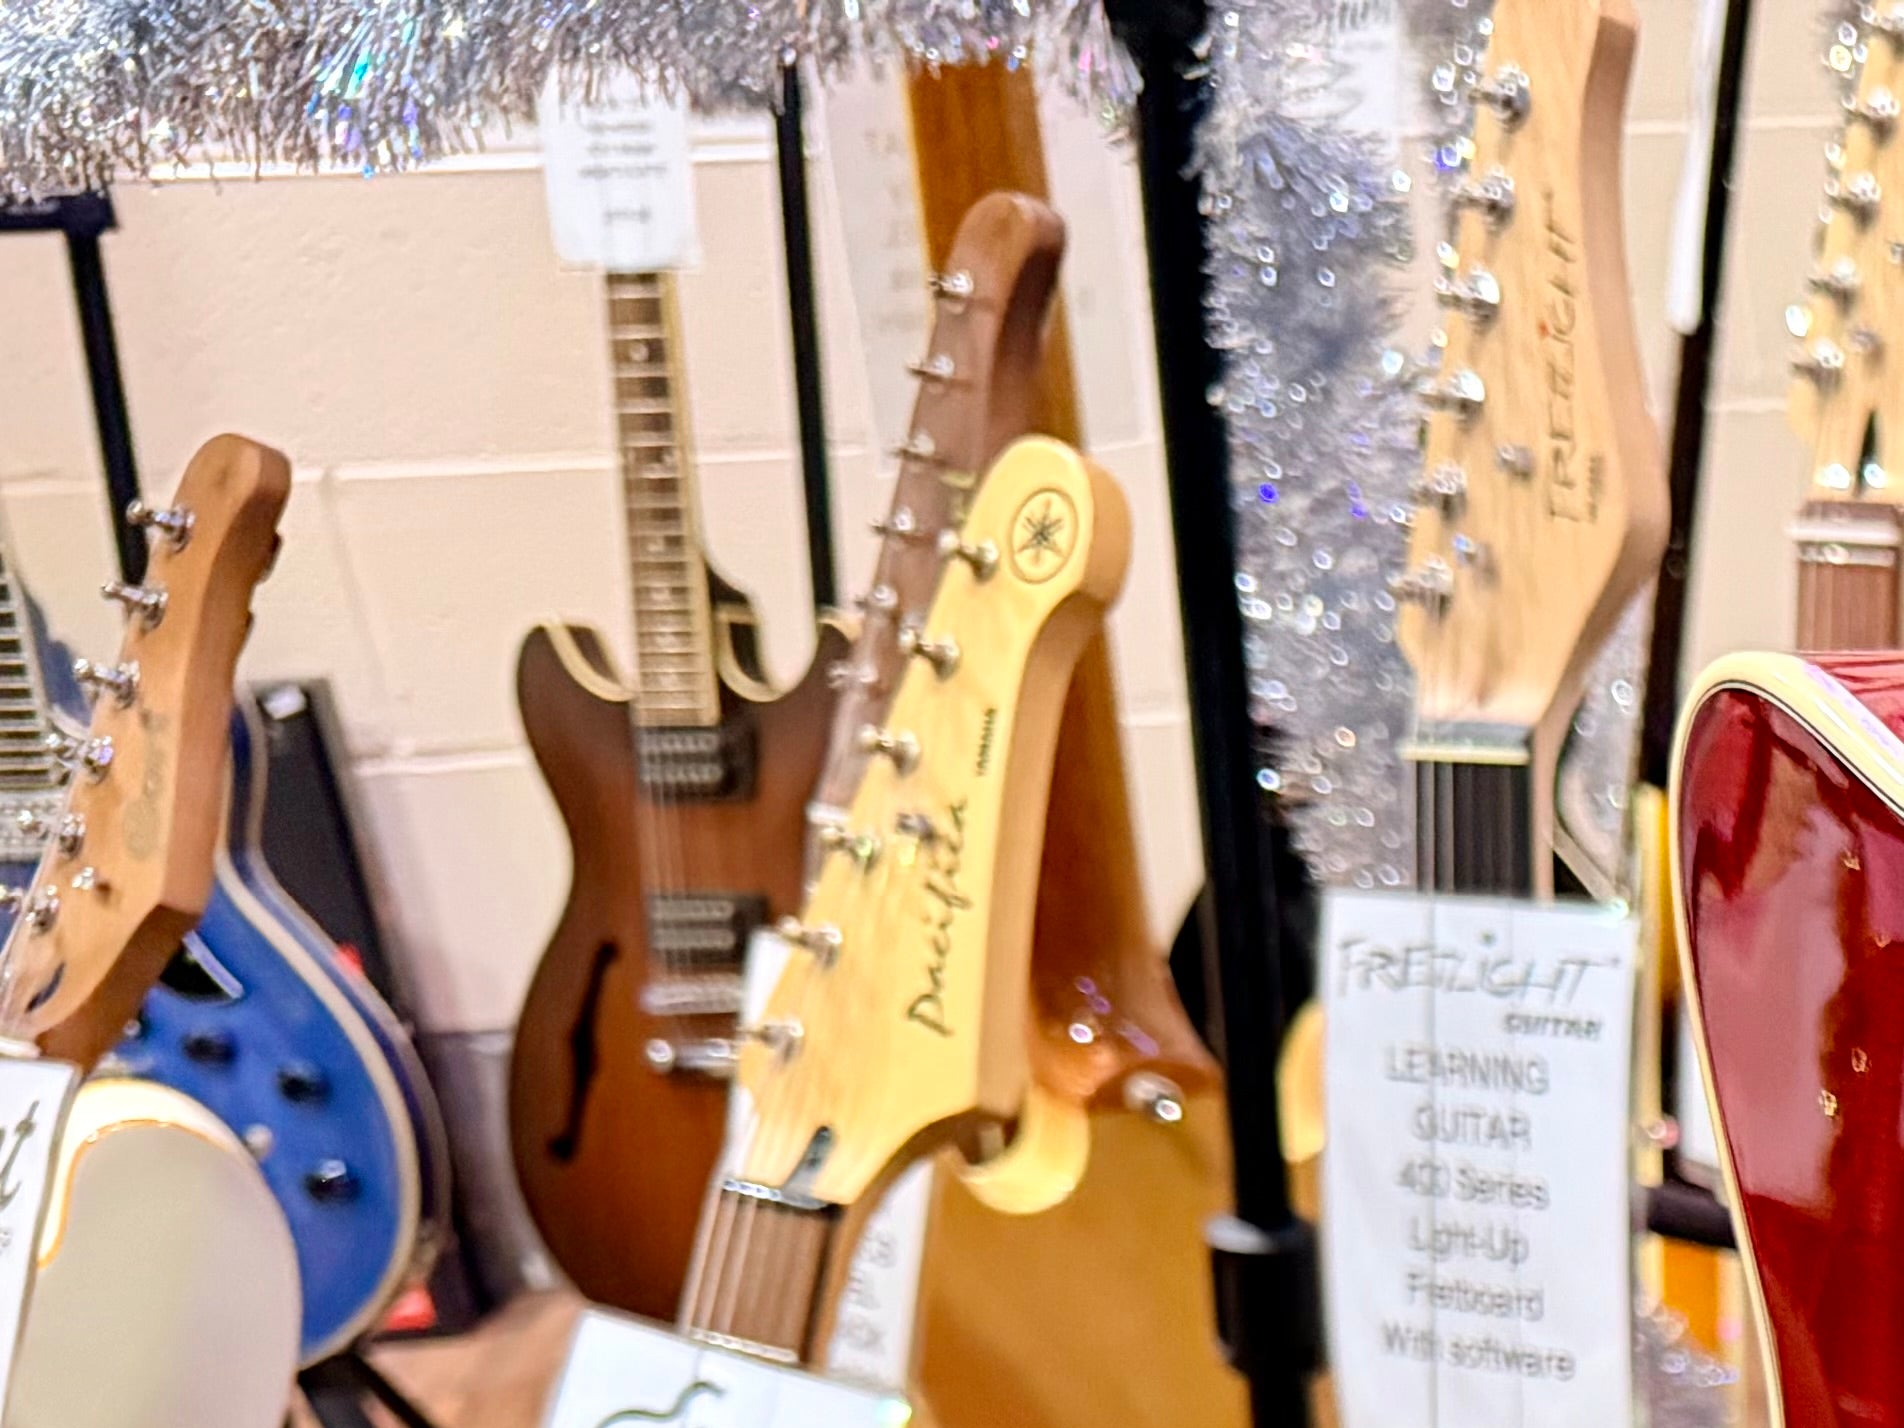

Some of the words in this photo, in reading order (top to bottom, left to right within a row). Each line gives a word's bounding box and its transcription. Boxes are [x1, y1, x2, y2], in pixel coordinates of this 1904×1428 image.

[1384, 1045, 1550, 1096] LEARNING
[1412, 1104, 1532, 1151] GUITAR
[1455, 1162, 1550, 1211] Series
[1408, 1216, 1530, 1271] Light-Up
[1449, 1334, 1577, 1382] software
